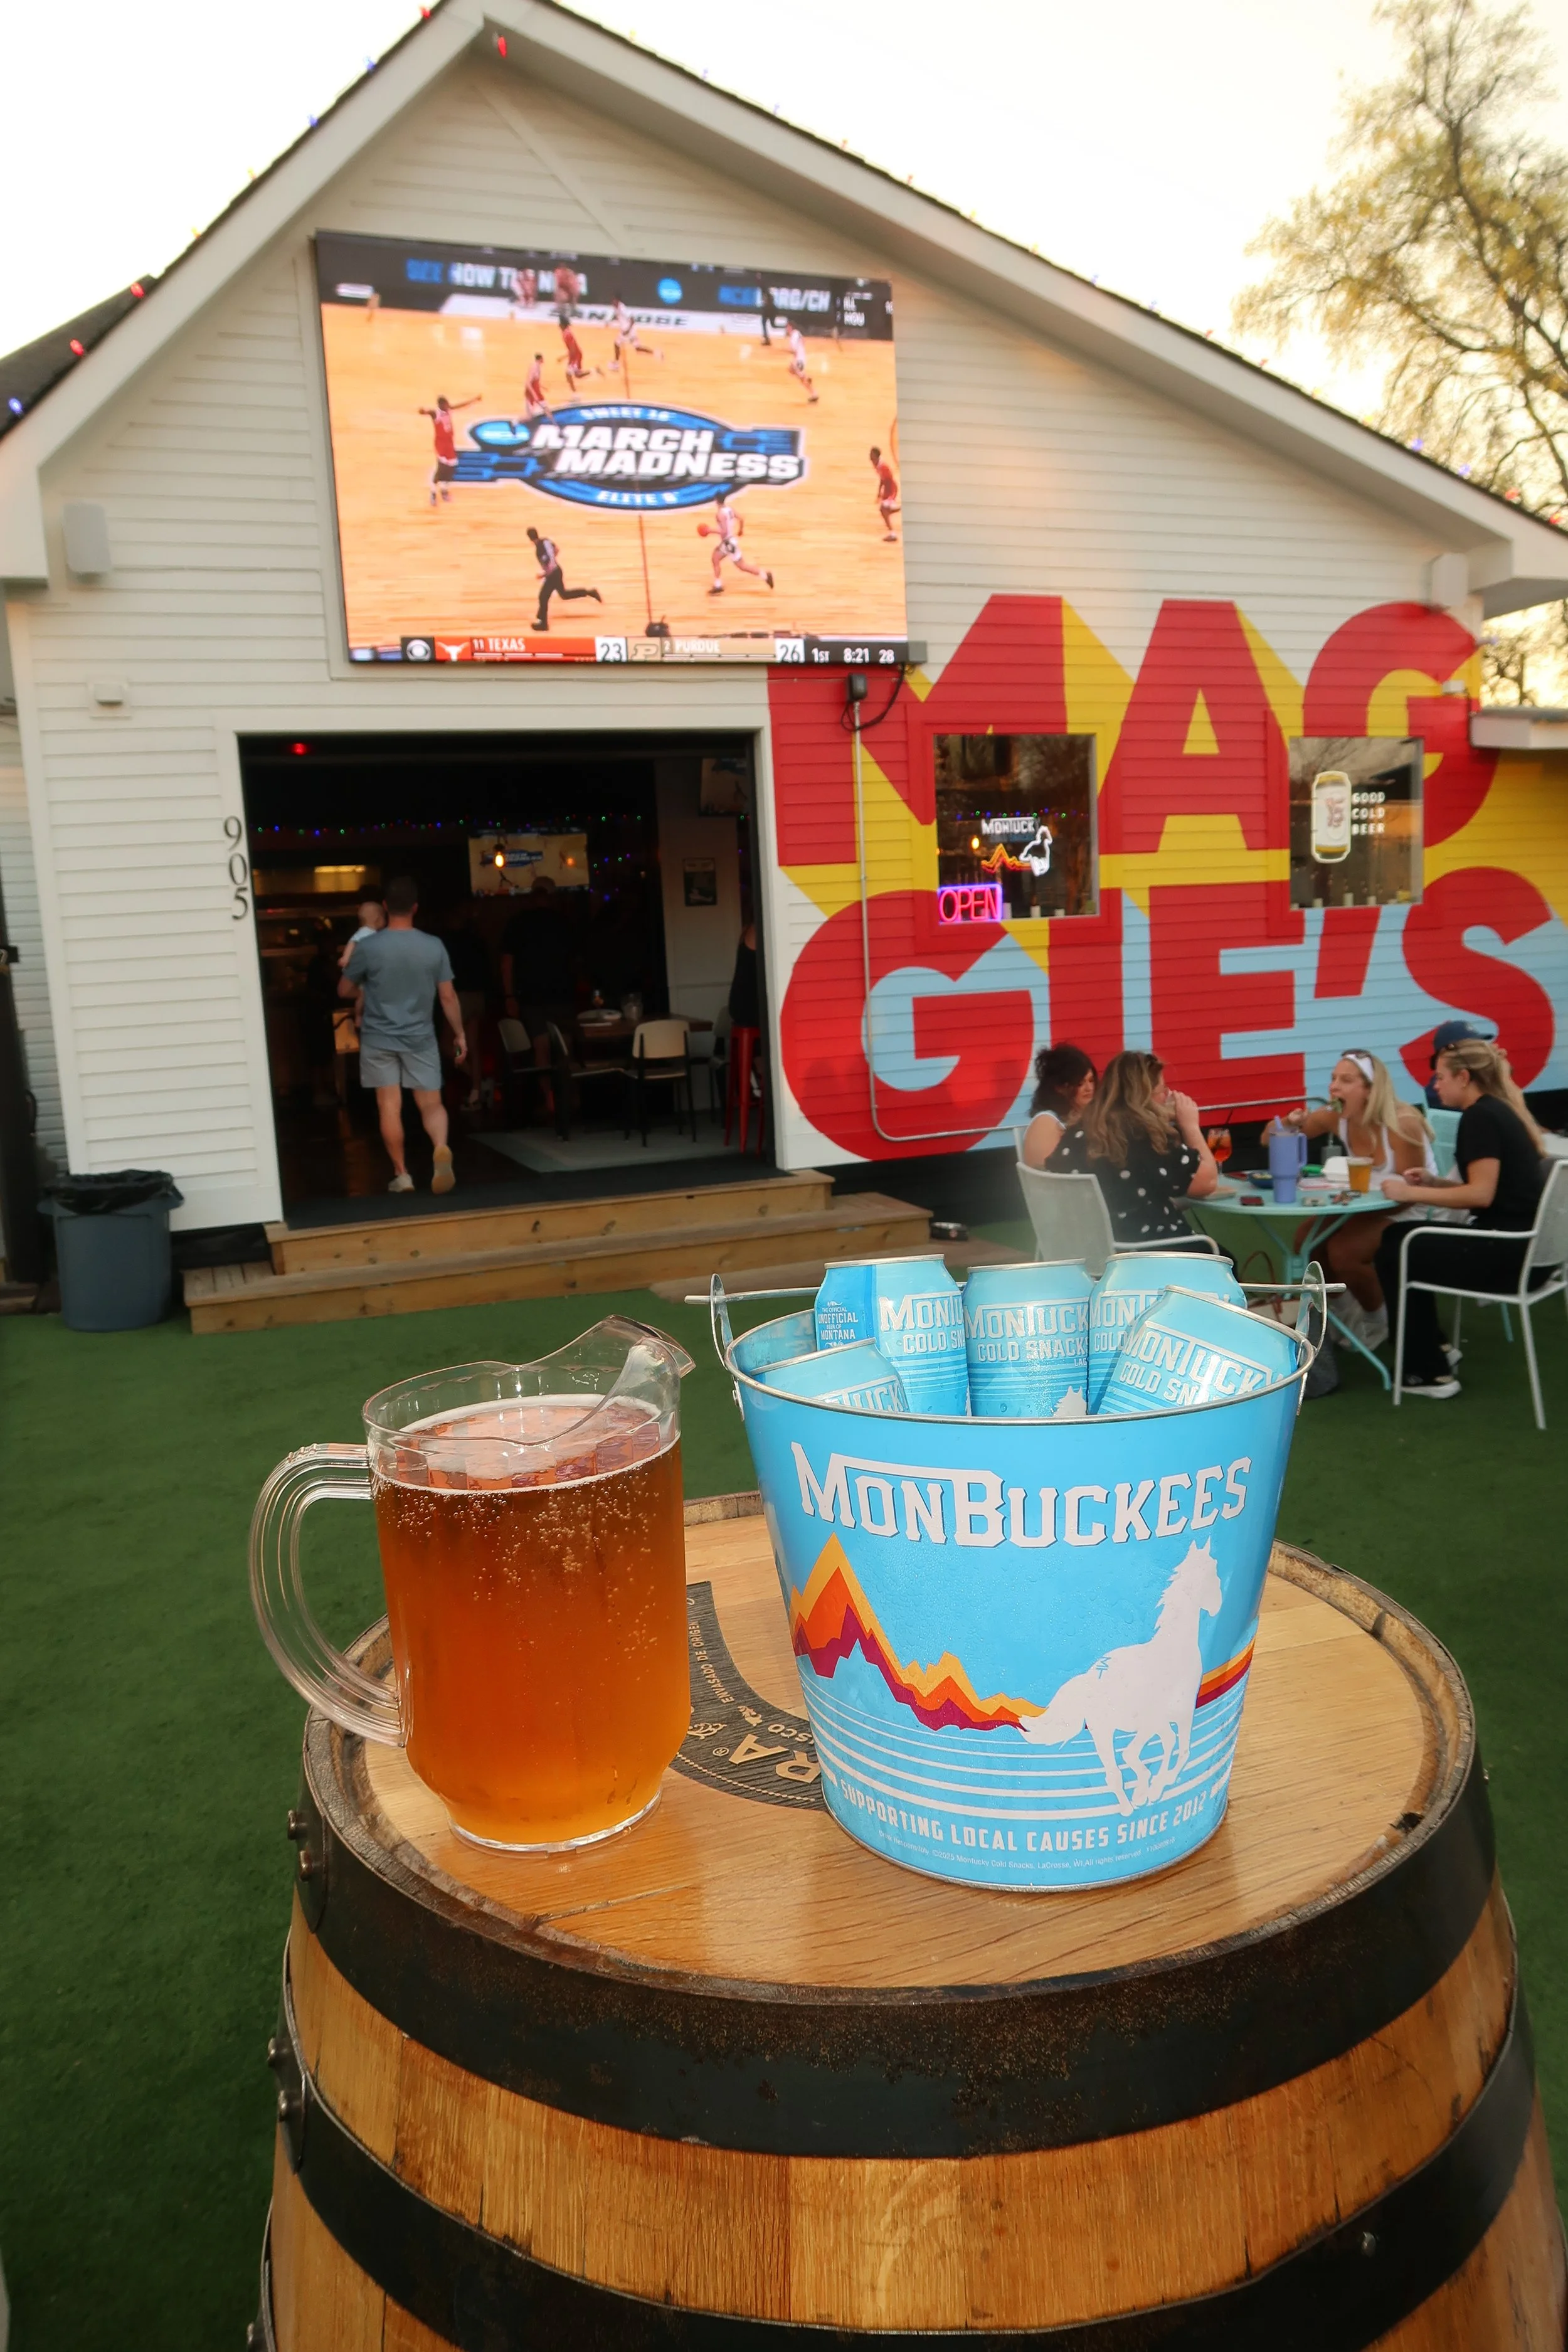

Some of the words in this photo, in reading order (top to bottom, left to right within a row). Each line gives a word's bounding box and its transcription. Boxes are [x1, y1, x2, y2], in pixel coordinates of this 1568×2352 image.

[531, 424, 715, 452] MARCH
[555, 448, 800, 480] MADNESS
[472, 637, 485, 651] 11
[487, 637, 526, 653] TEXAS
[600, 643, 623, 662] 23
[675, 639, 721, 654] PURDUE
[780, 644, 800, 663] 26
[843, 648, 869, 663] 8:21
[879, 649, 895, 663] 28
[1352, 792, 1385, 805] GOOD
[1352, 807, 1385, 820] COLD
[1352, 822, 1385, 835] BEER
[224, 815, 248, 921] 905
[940, 887, 999, 923] OPEN
[818, 1312, 859, 1324] UNOFFICIAL
[879, 1290, 964, 1332] MONTU
[964, 1296, 1089, 1339] MONTUCK
[820, 1328, 856, 1340] MONTANA
[903, 1332, 948, 1355] COLD
[1094, 1330, 1128, 1352] COLD
[977, 1341, 1020, 1362] COLD
[1073, 1358, 1087, 1367] LAG
[1119, 1361, 1162, 1394] COLD
[694, 1650, 707, 1663] DE
[700, 1663, 735, 1705] ENVASADO
[840, 1779, 944, 1841] SUPPORTING
[950, 1824, 1019, 1851] LOCAL
[1027, 1826, 1110, 1852] CAUSES
[1117, 1810, 1169, 1845] SINCE
[1173, 1790, 1207, 1827] 2012
[956, 1854, 990, 1867] Montucky
[991, 1859, 1007, 1868] Cold
[1095, 1857, 1114, 1866] rights
